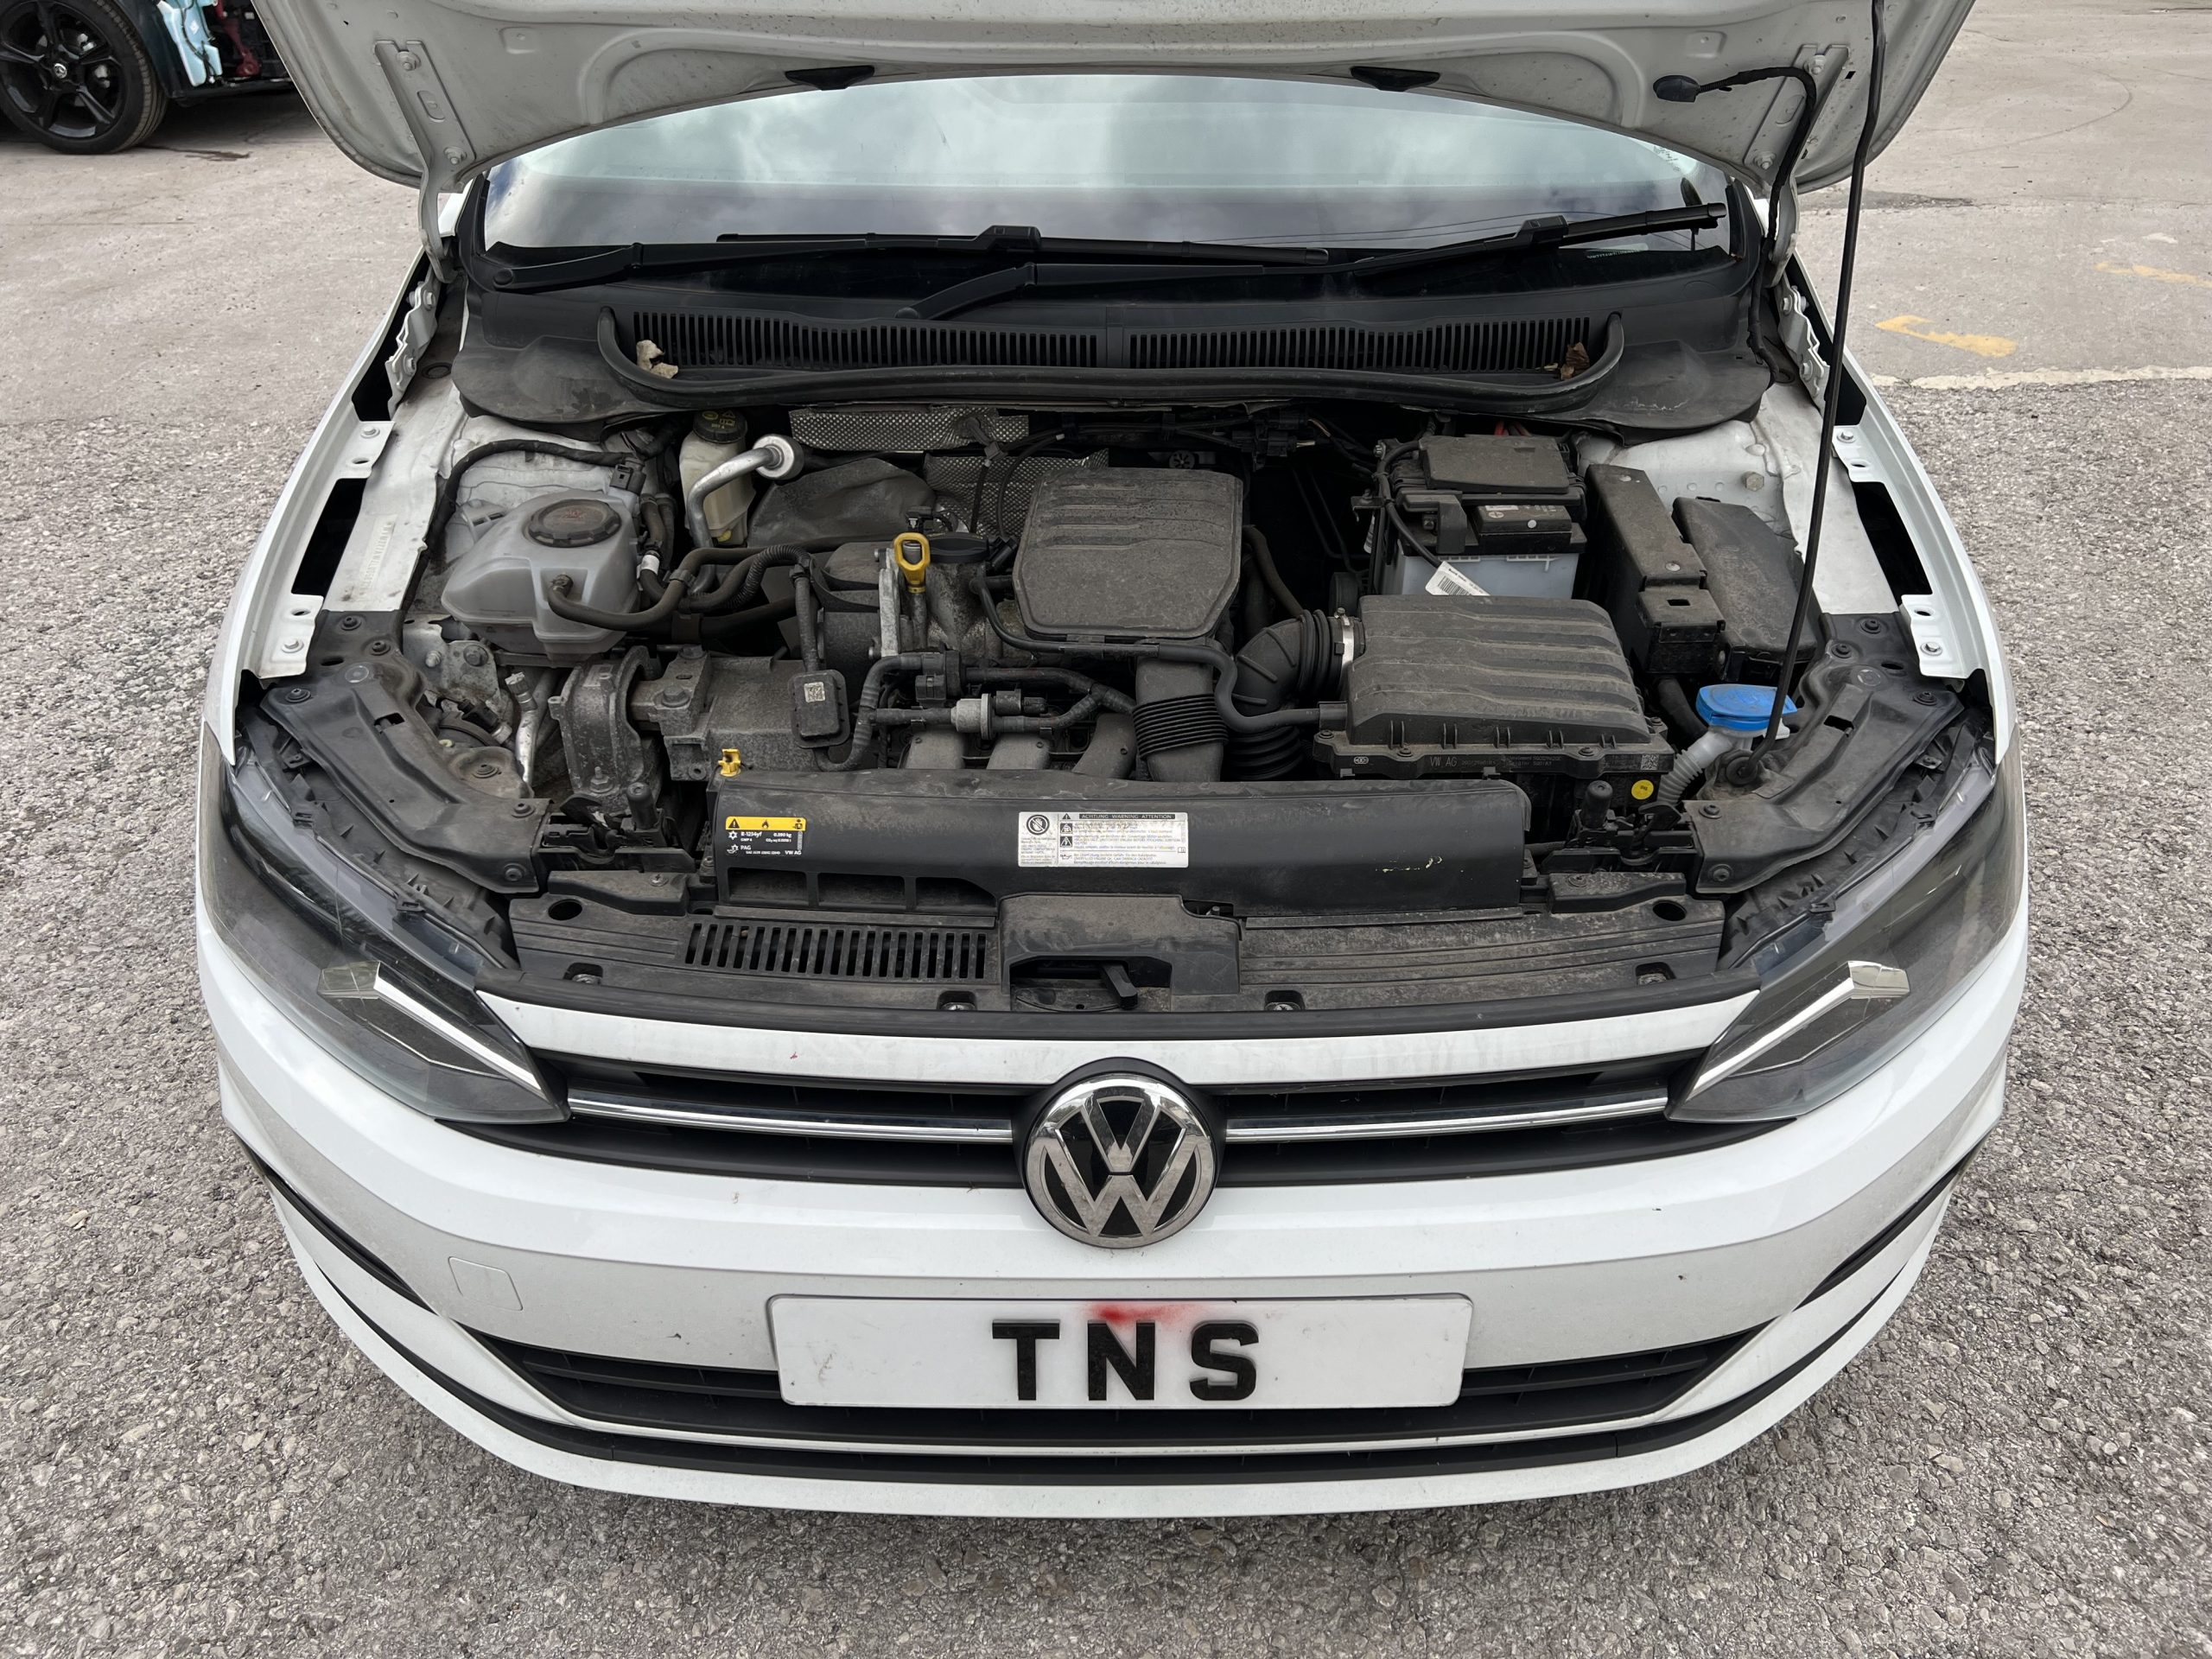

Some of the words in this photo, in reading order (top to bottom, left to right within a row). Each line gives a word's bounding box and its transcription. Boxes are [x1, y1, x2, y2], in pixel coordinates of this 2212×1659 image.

[1429, 756, 1441, 766] VW
[1446, 756, 1458, 766] AG
[991, 1319, 1260, 1402] TNS
